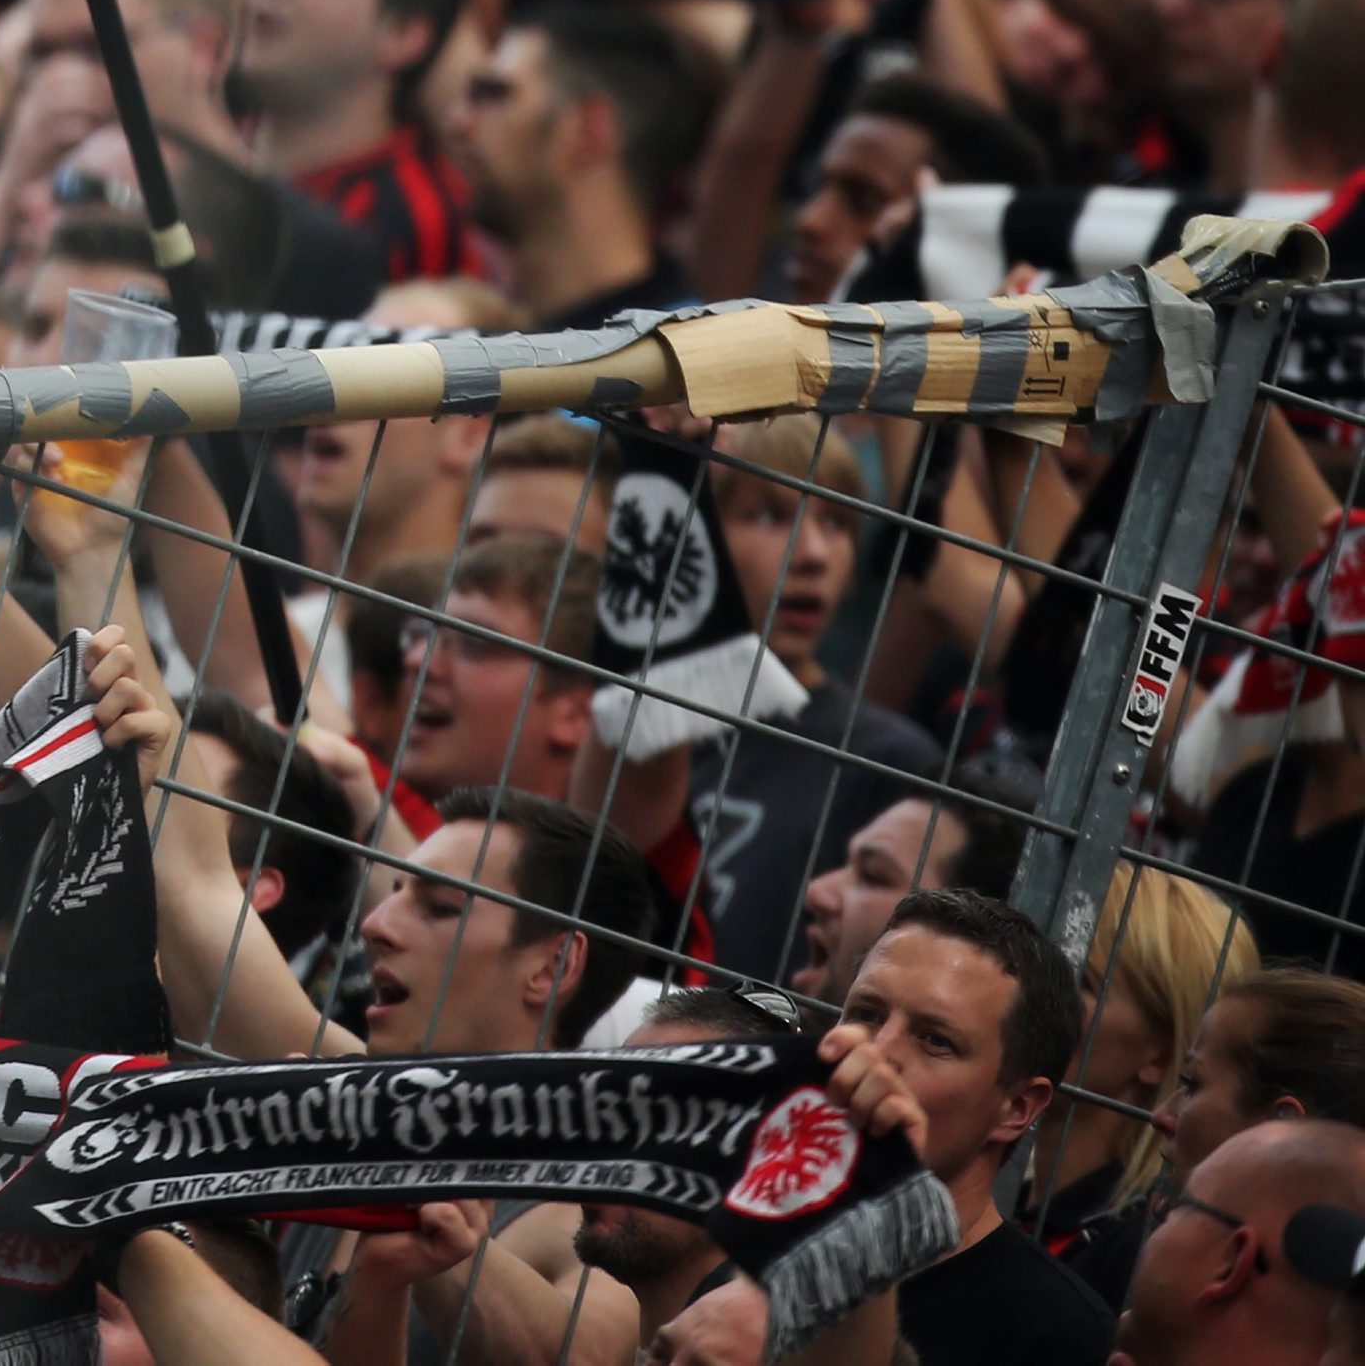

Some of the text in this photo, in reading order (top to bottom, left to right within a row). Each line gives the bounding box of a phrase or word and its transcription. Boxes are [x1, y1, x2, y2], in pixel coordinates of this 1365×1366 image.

[1139, 593, 1197, 684] FFM
[45, 1066, 767, 1174] Eintracht Frankfurt
[150, 1168, 280, 1207] EINTRACHT
[284, 1162, 414, 1190] FRANKFURT
[416, 1160, 456, 1184] FÜR
[464, 1161, 529, 1184] IMMER
[580, 1162, 636, 1188] EWIG
